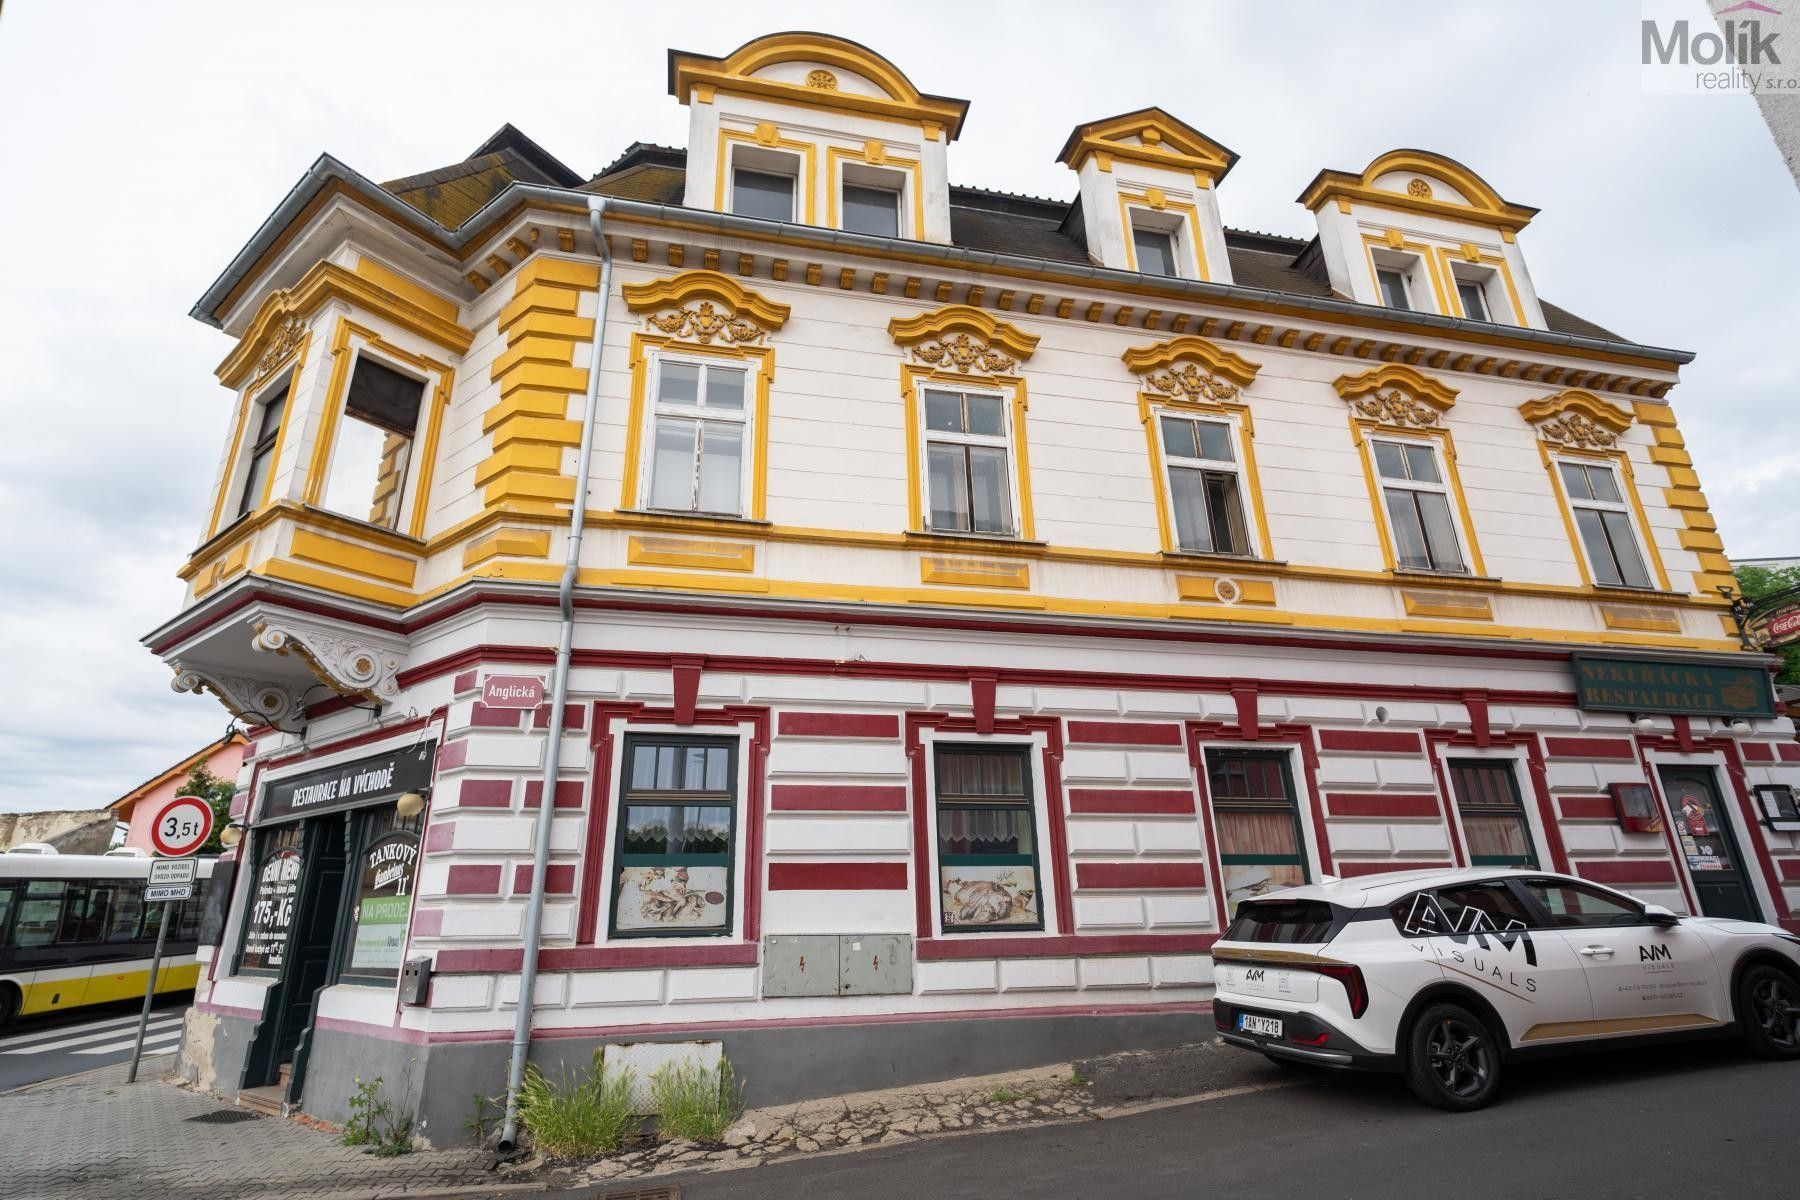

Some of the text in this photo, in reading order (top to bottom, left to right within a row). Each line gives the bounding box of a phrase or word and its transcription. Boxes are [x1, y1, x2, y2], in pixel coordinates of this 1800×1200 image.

[488, 684, 536, 700] Anglická
[1585, 687, 1717, 709] RESTAURACE
[291, 761, 396, 808] RESTAURACE NA VÝCHODĚ
[193, 821, 200, 836] t
[369, 843, 418, 869] TANKOVÝ
[150, 888, 186, 898] MIMO MHD
[361, 903, 375, 919] NA
[1411, 943, 1537, 993] VISUALS
